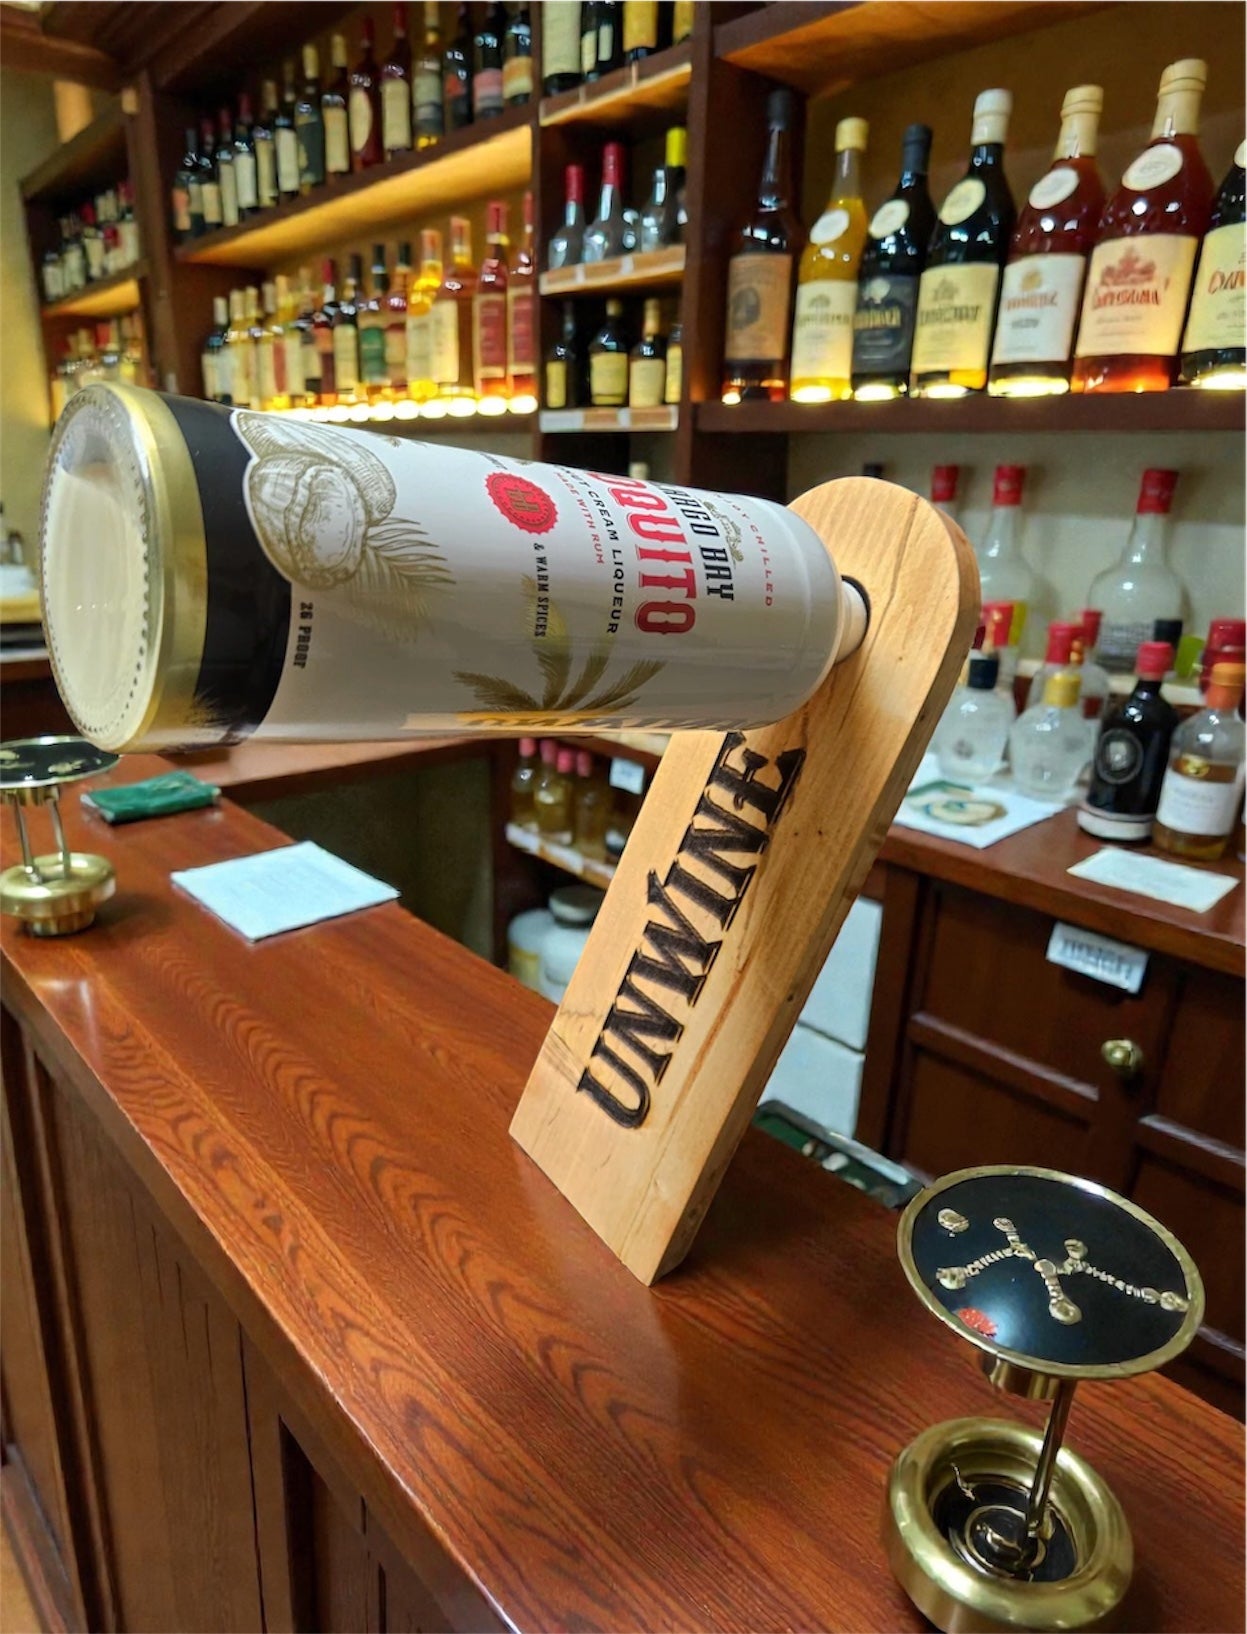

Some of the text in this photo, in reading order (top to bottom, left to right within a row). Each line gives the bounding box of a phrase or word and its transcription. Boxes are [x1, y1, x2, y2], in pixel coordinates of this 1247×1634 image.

[577, 498, 596, 529] WITH
[591, 533, 605, 564] RUM
[588, 490, 620, 541] CREAM
[606, 549, 624, 634] LIQUEUR
[657, 483, 735, 601] ARGO BAY
[750, 524, 773, 607] CHILLED
[293, 602, 313, 669] 26 PROOF
[533, 542, 549, 637] & WARM SPICES
[577, 731, 806, 1130] UNWINE
